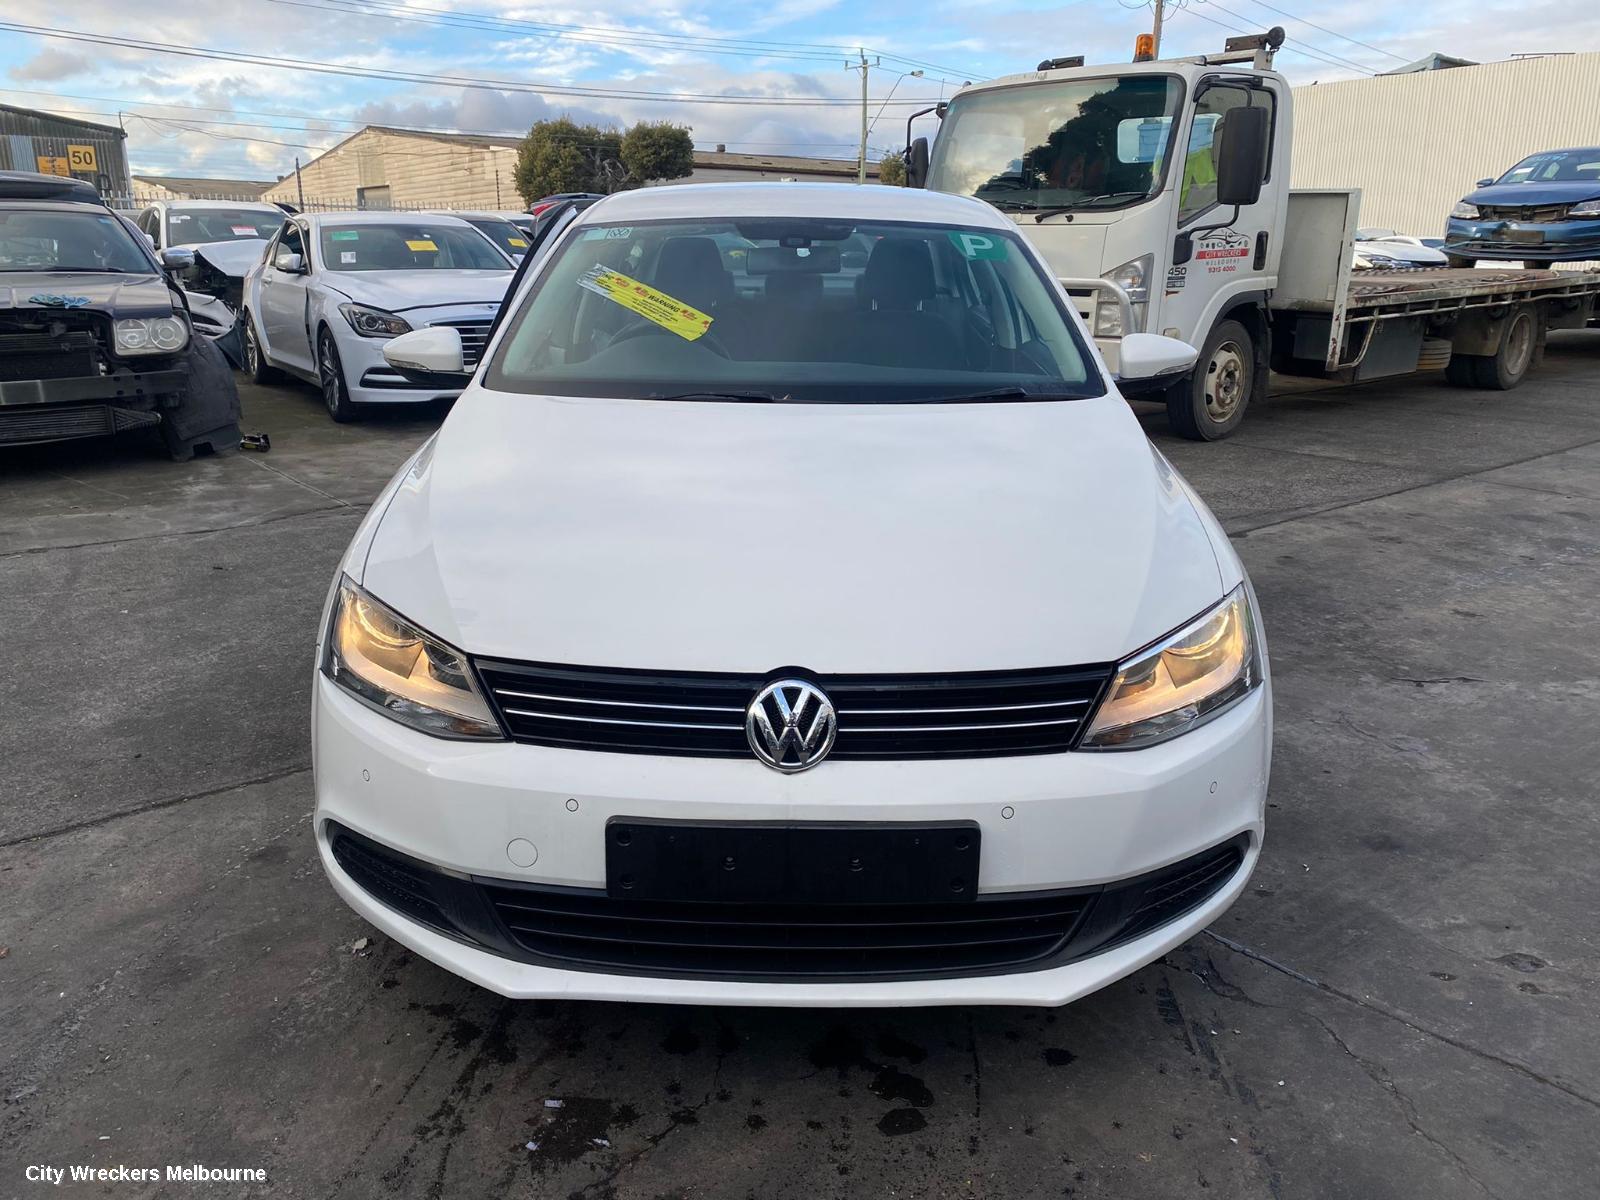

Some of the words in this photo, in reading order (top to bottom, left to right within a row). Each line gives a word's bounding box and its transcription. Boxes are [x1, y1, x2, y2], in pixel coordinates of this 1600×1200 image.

[72, 150, 93, 166] 50
[960, 234, 993, 256] P
[1168, 267, 1187, 275] 450
[648, 294, 681, 313] WARNING
